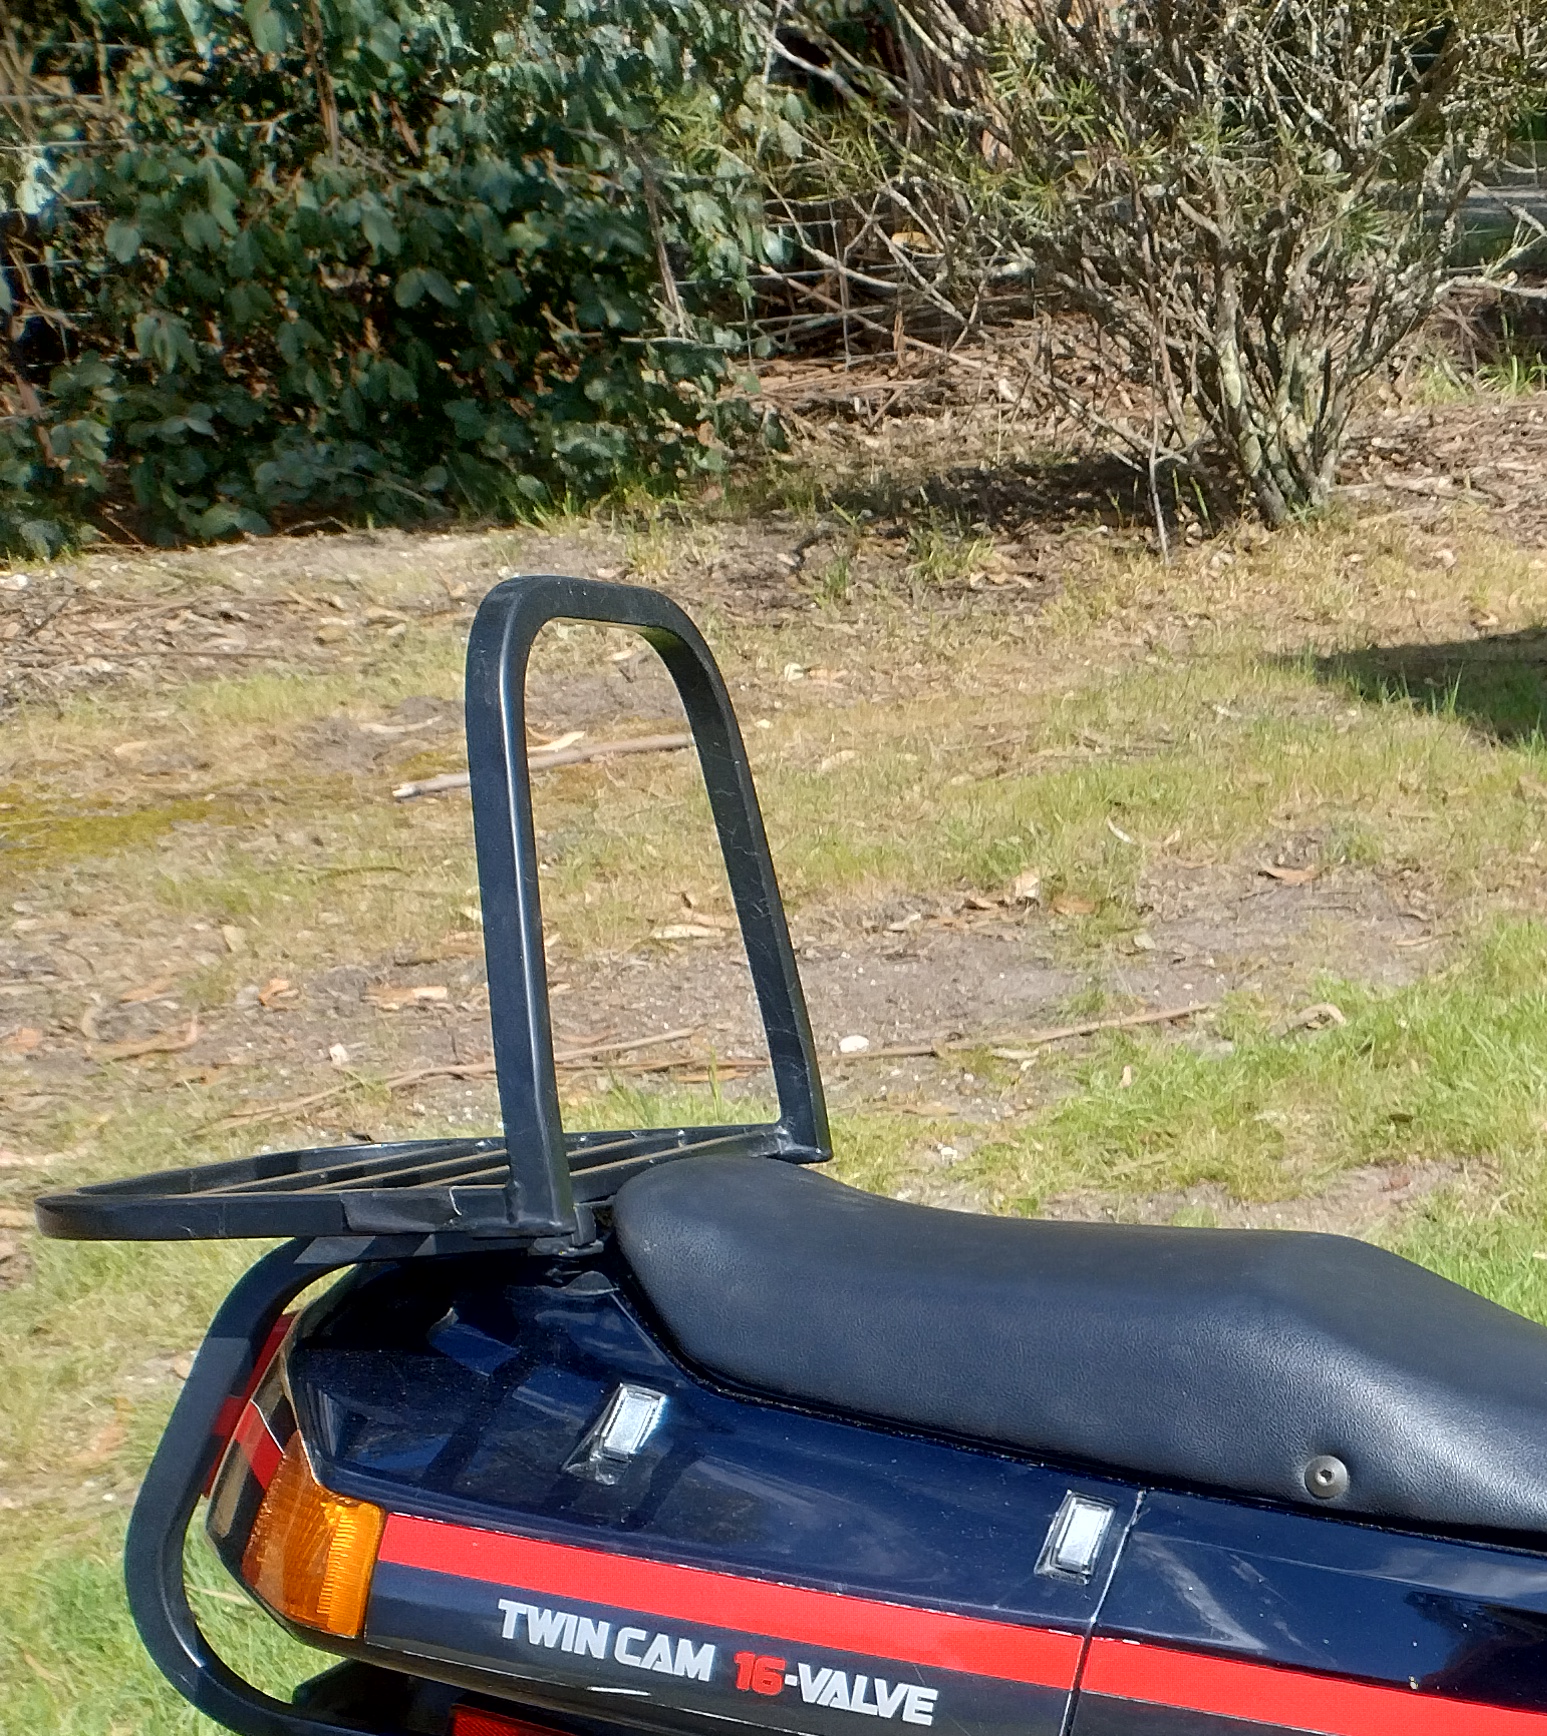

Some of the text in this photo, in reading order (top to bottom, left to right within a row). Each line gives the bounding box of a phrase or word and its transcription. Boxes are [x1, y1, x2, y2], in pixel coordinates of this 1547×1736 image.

[499, 1598, 939, 1727] TWIN CAM 16-VALVE
